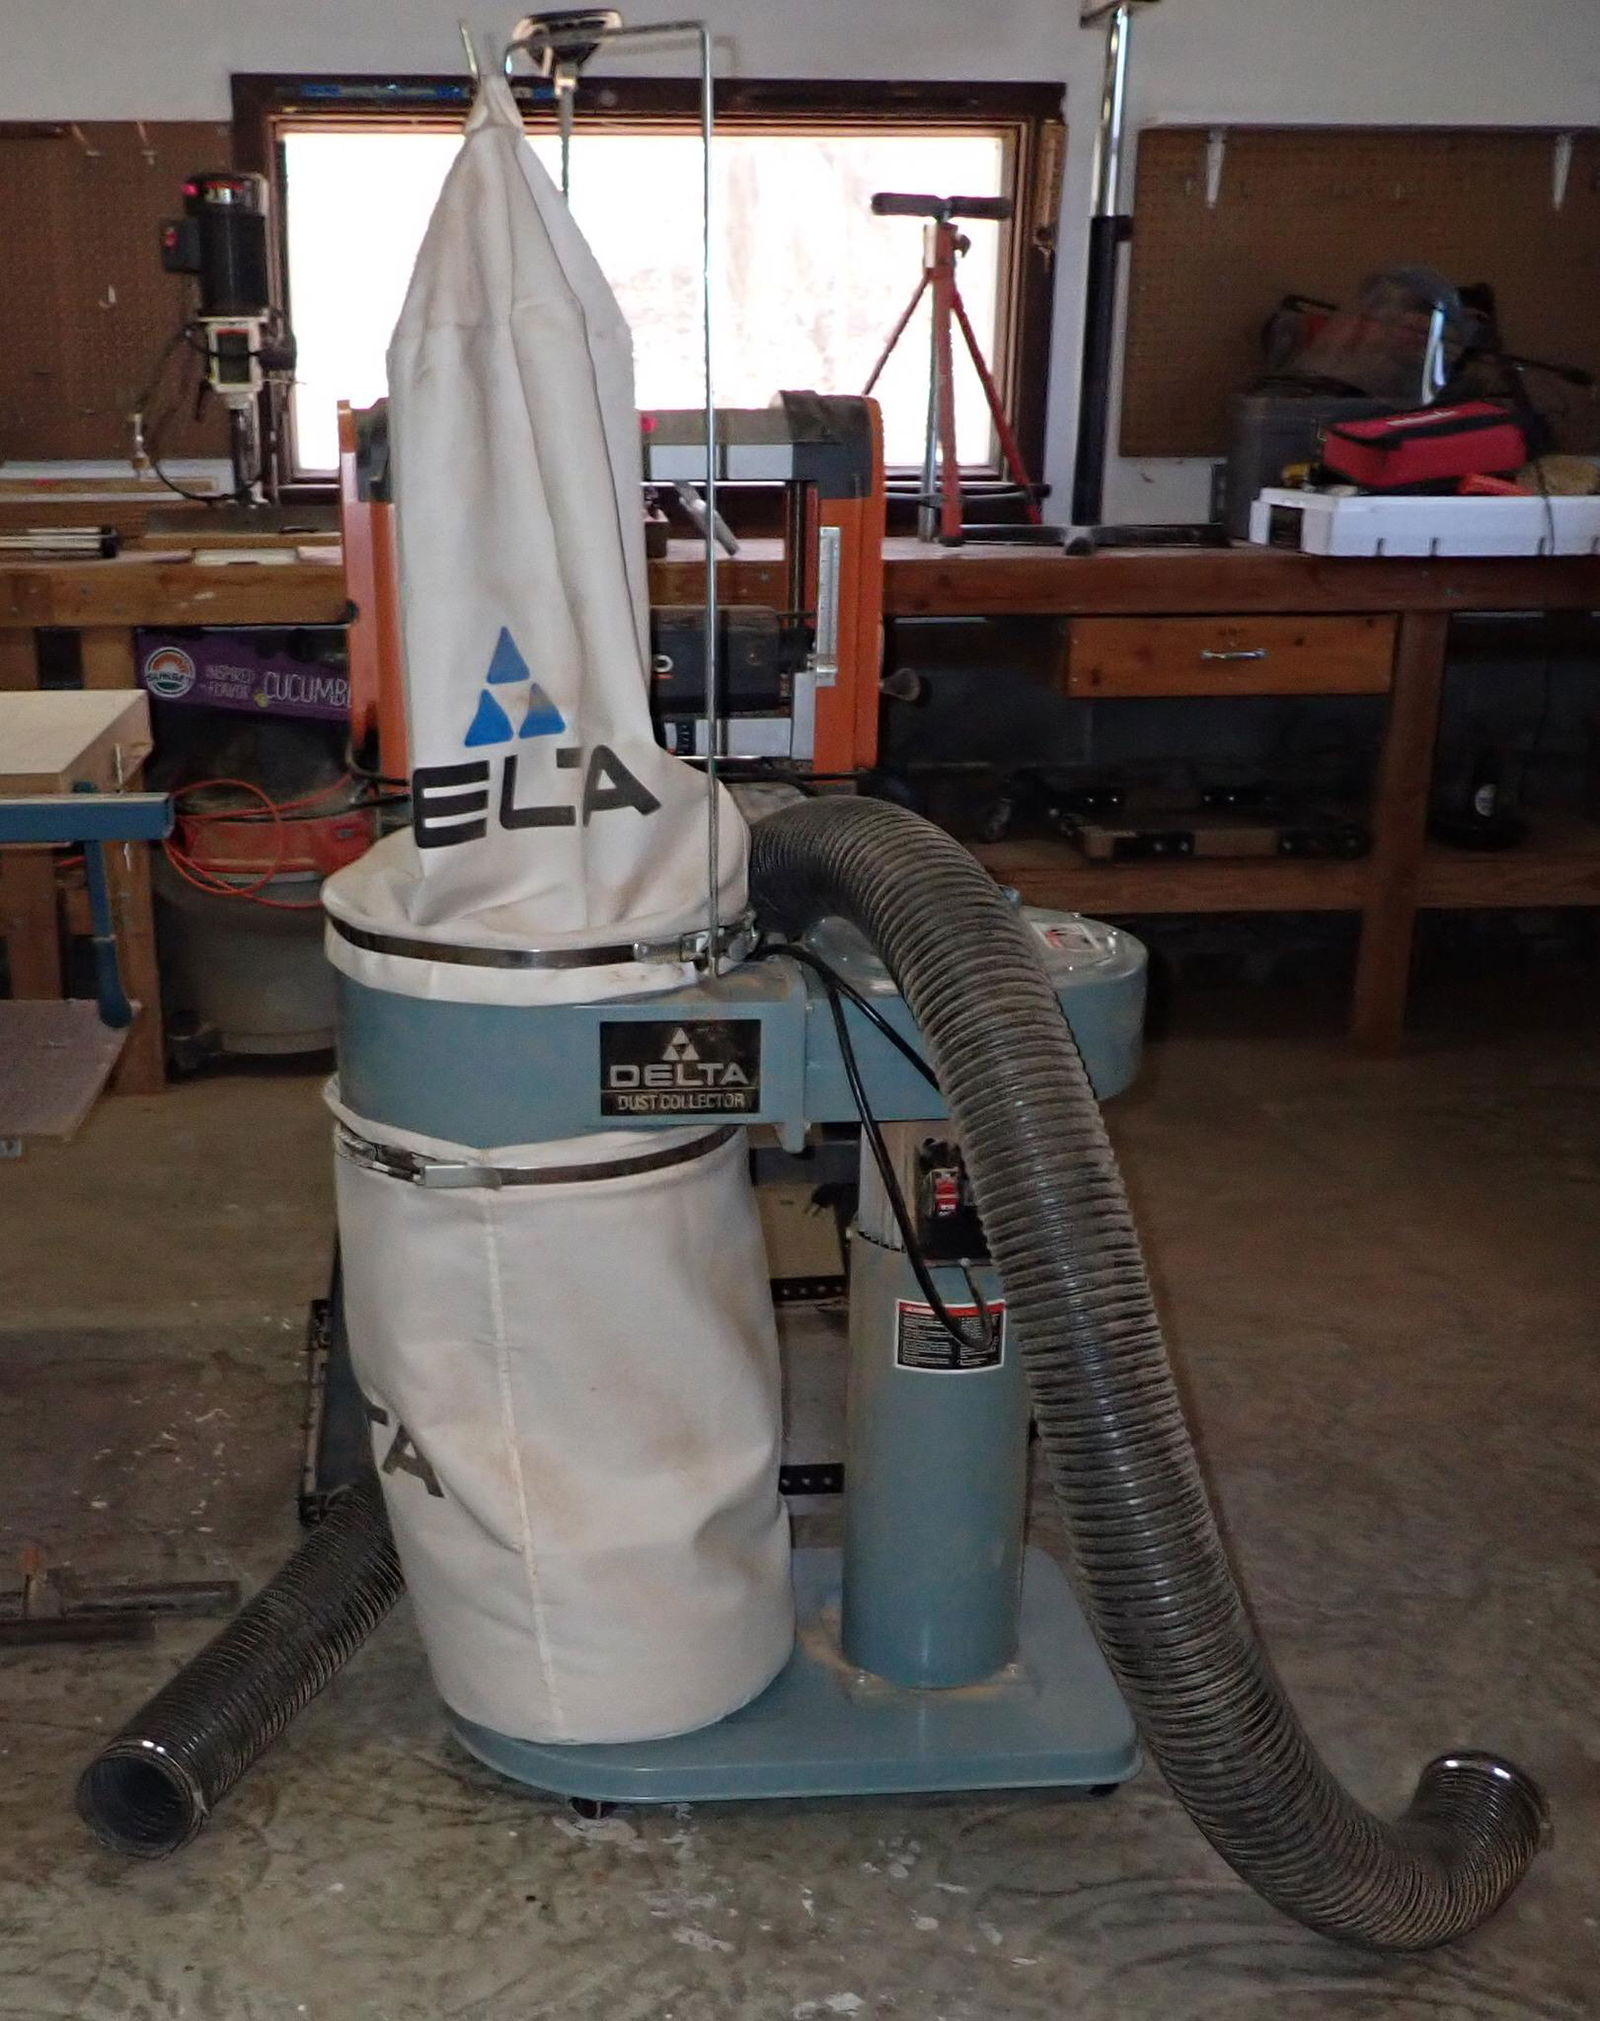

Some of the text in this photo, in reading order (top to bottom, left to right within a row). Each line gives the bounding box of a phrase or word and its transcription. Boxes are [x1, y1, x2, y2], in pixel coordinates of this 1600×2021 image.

[609, 1062, 750, 1088] DELTA
[618, 1092, 746, 1111] DUST COLLECTOR
